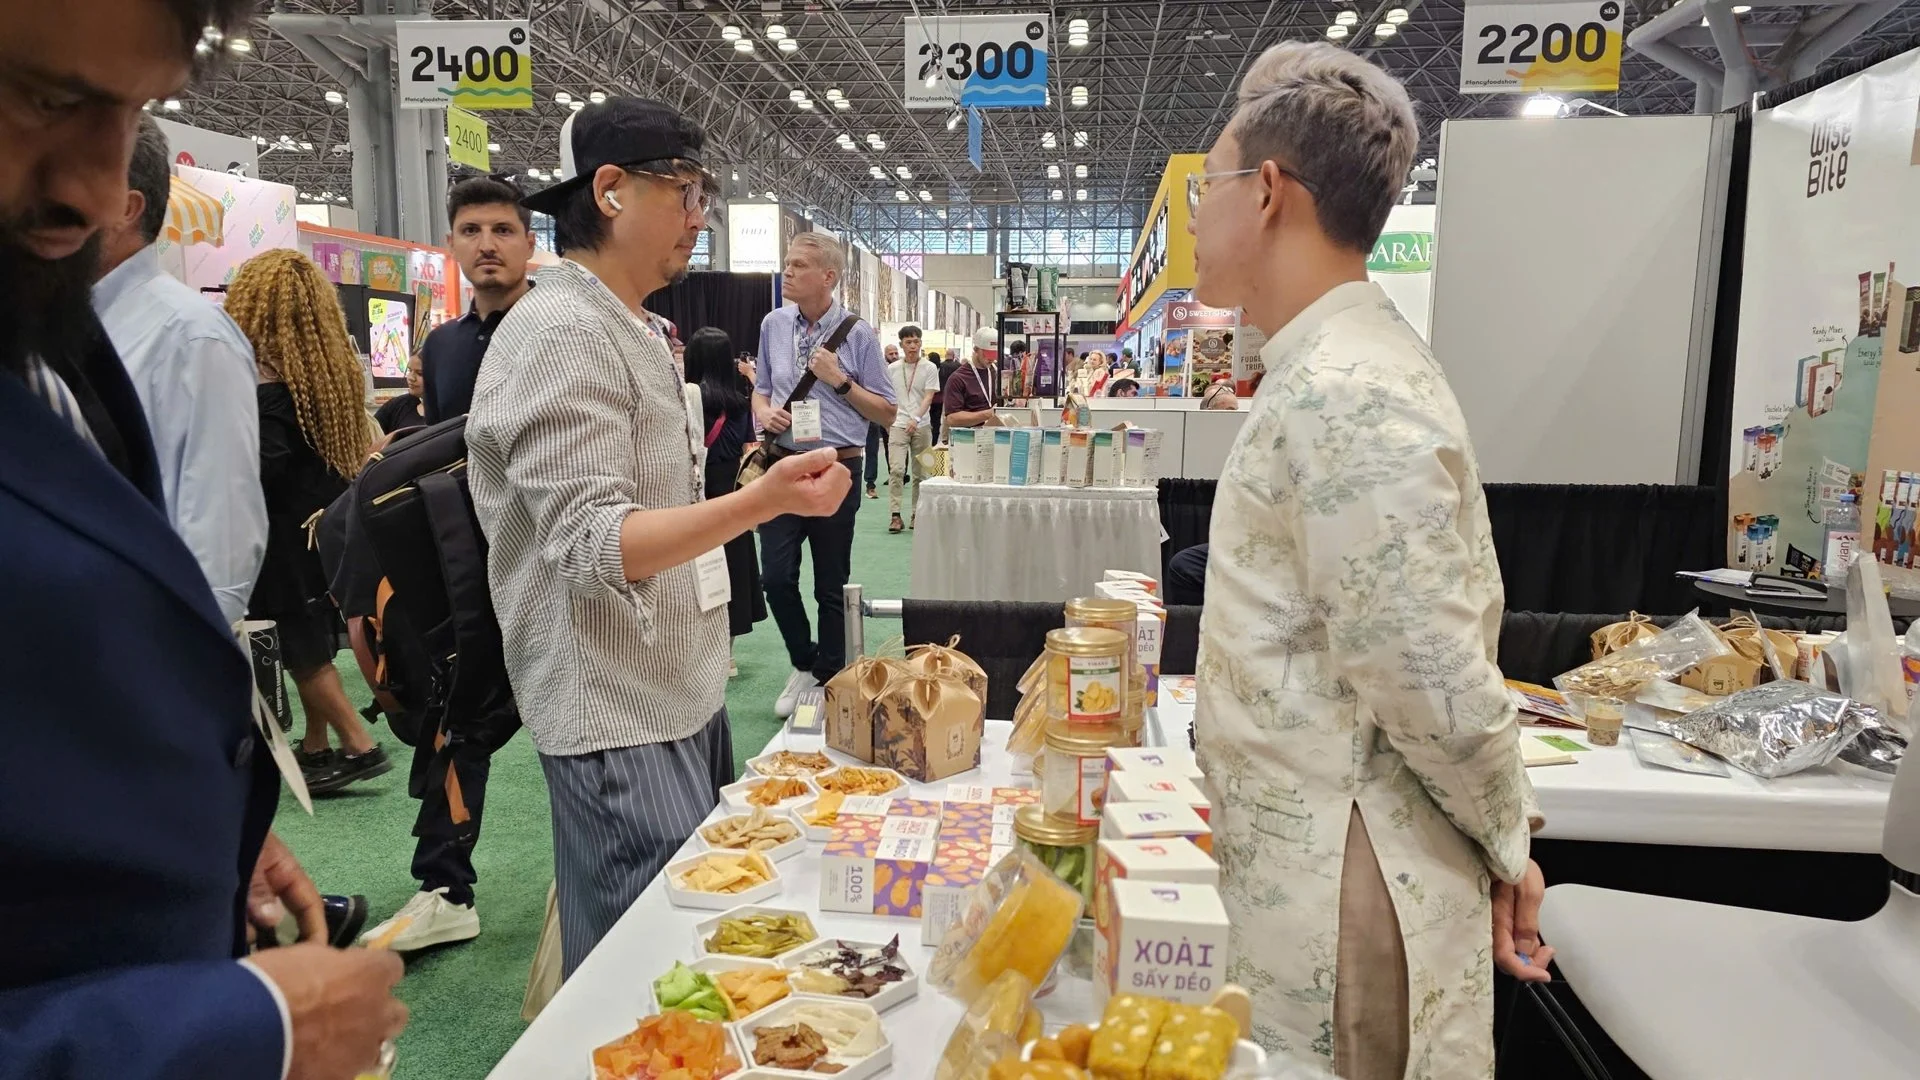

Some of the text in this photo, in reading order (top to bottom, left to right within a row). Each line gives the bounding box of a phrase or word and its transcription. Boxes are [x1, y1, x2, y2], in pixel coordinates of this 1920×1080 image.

[918, 41, 1034, 80] 2300
[1478, 22, 1606, 64] 2200
[410, 45, 519, 82] 2400
[455, 125, 482, 153] 2400
[1807, 151, 1848, 198] Bite
[420, 263, 435, 280] XO
[1366, 242, 1434, 264] ARA
[850, 866, 862, 903] 100%
